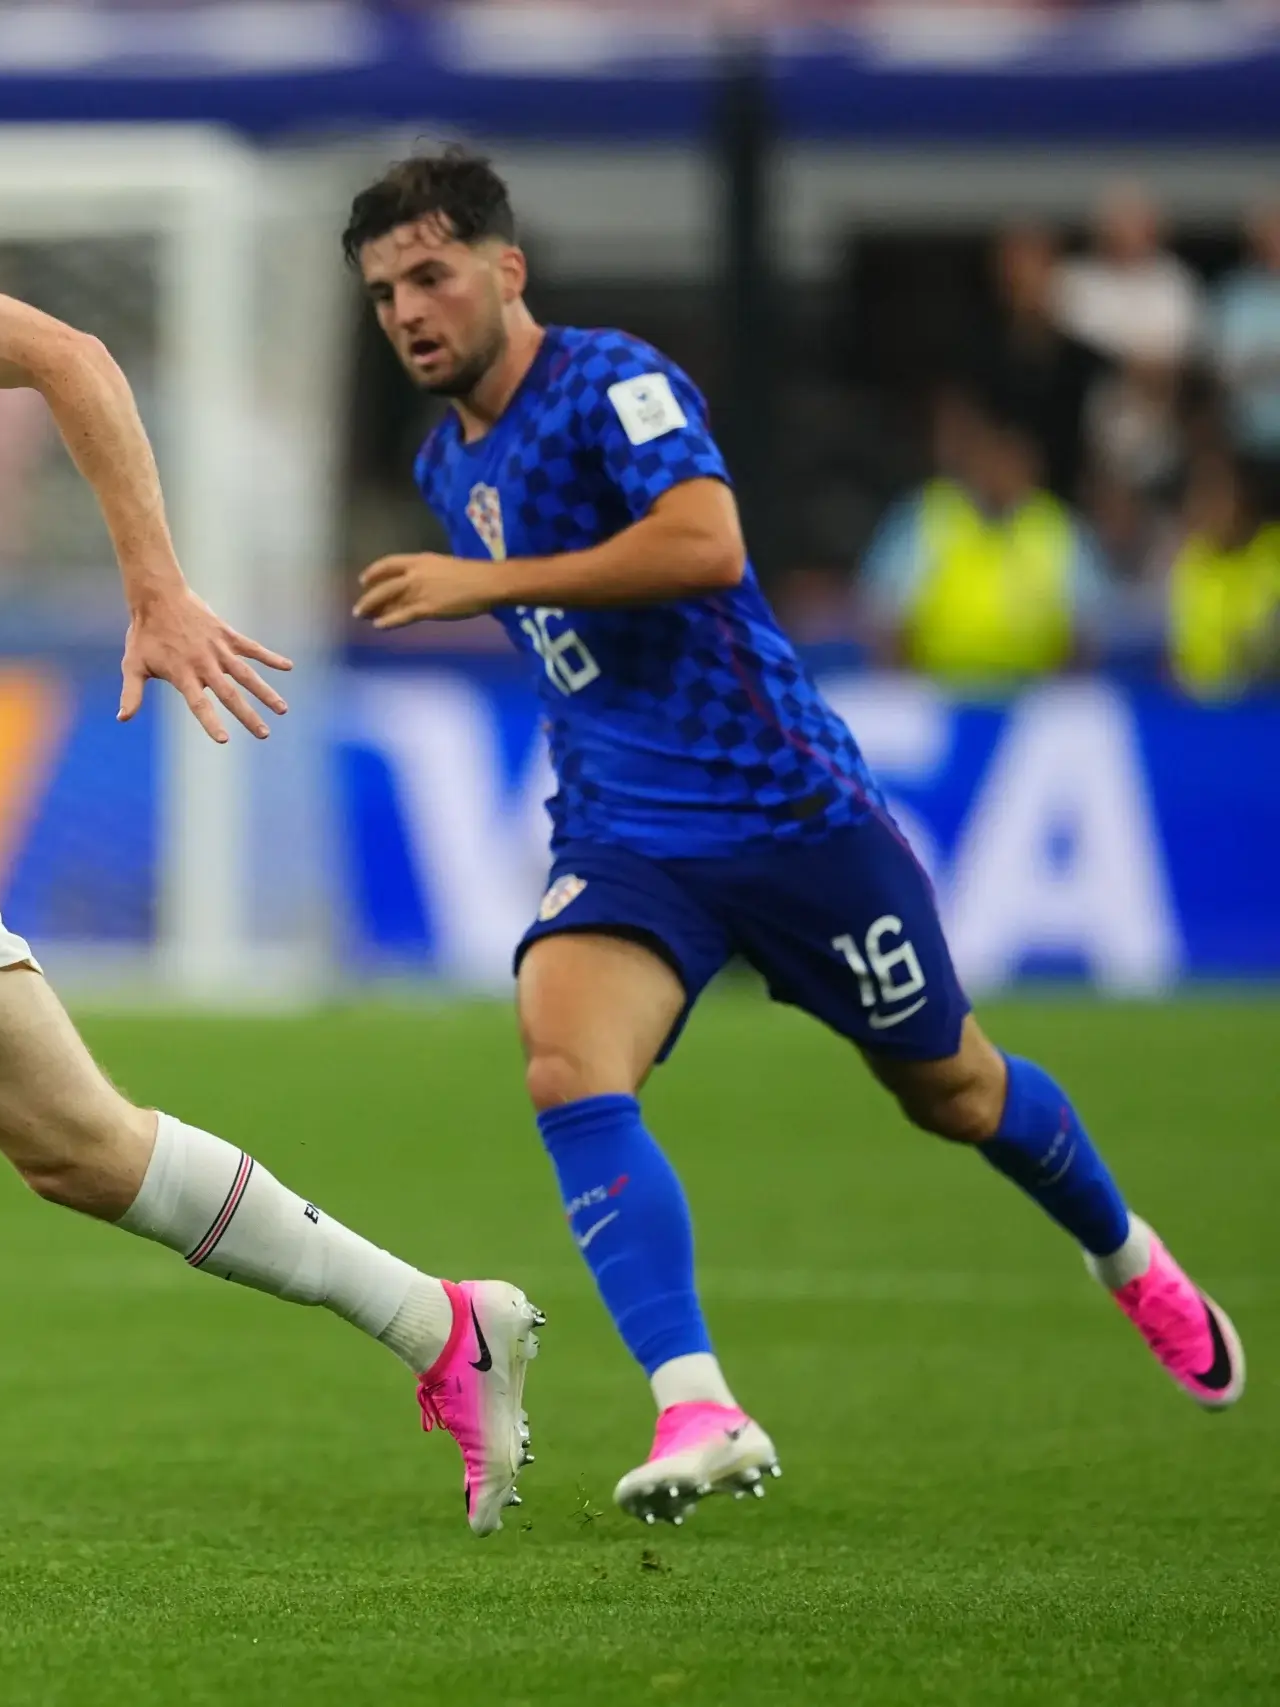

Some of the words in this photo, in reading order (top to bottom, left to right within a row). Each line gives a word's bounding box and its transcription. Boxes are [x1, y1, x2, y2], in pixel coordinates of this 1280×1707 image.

[516, 606, 601, 697] 16
[350, 672, 1186, 998] VA
[830, 914, 926, 1008] 16
